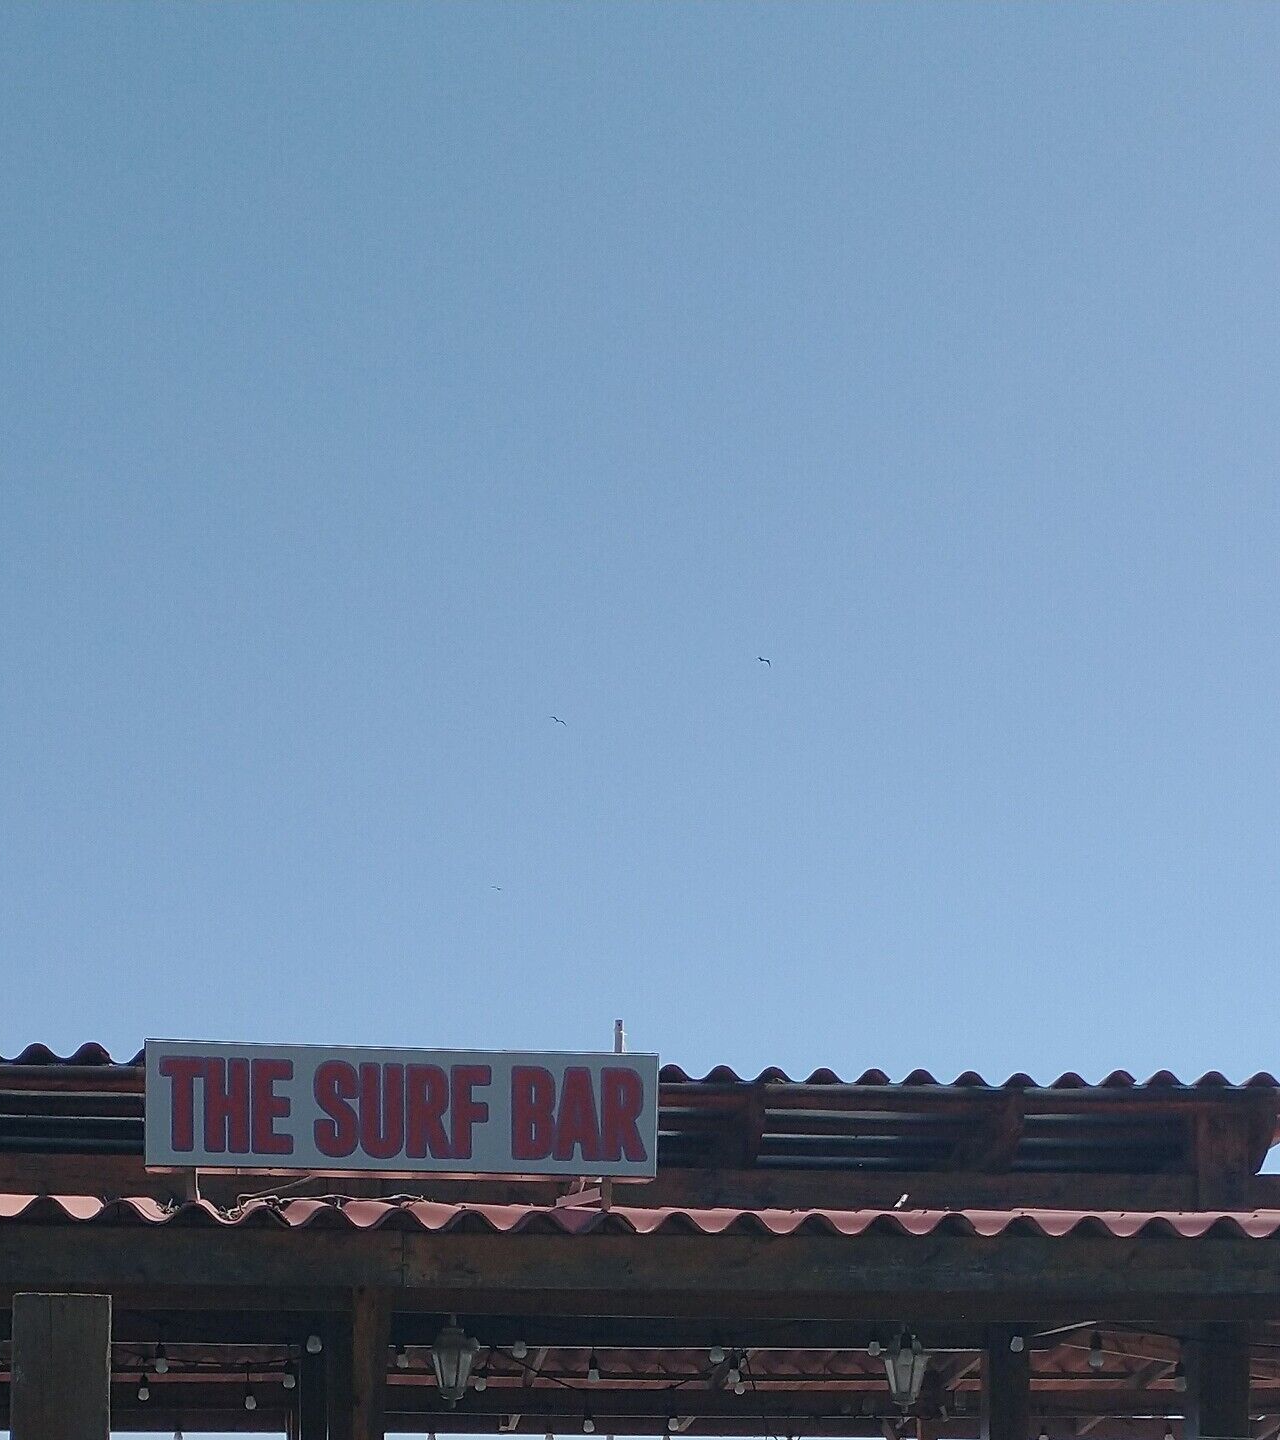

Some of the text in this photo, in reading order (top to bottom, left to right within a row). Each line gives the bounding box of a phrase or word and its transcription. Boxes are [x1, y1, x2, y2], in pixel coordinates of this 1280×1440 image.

[159, 1055, 647, 1161] THE SURF BAR
